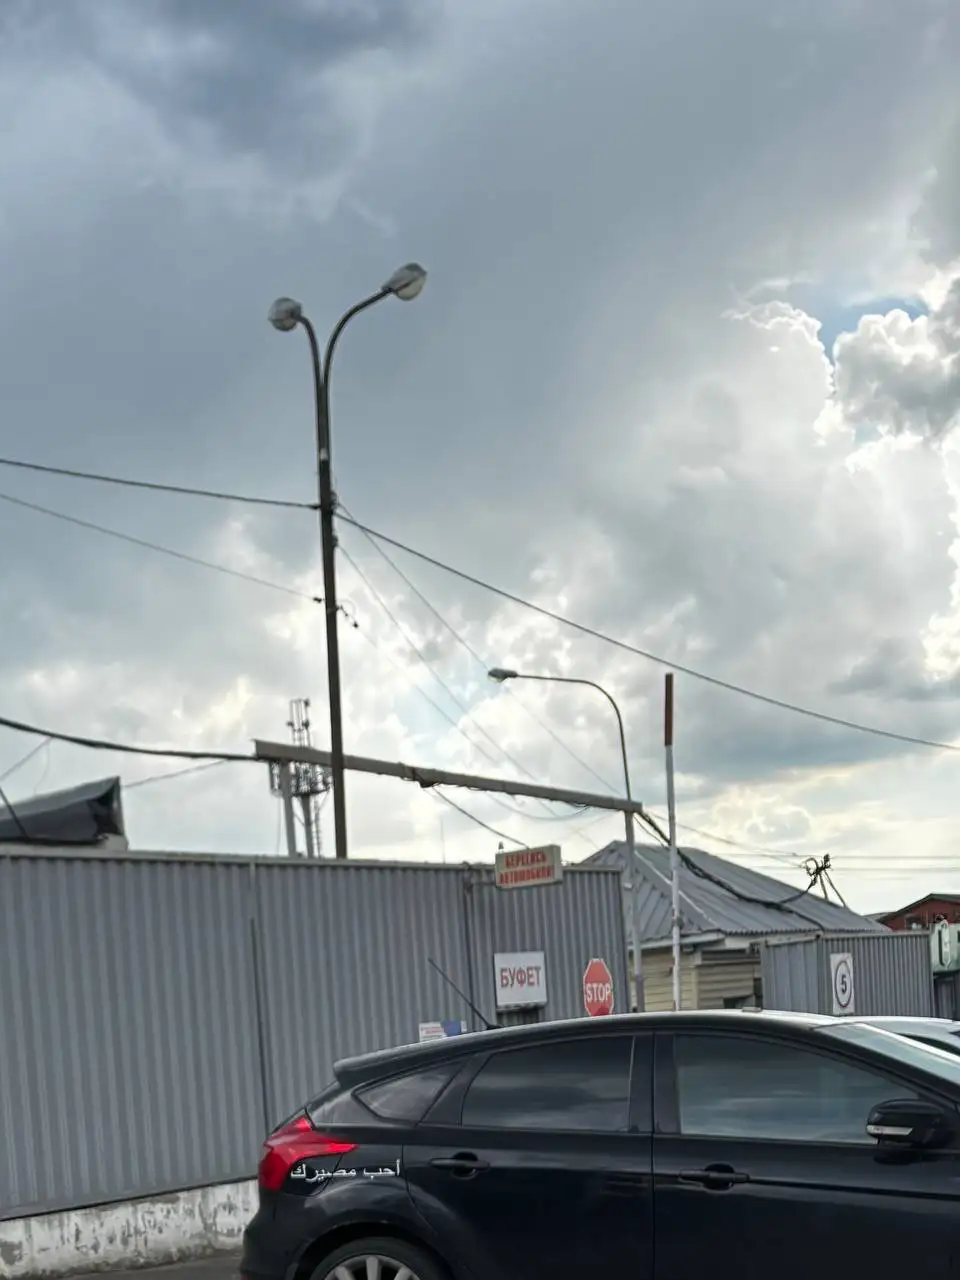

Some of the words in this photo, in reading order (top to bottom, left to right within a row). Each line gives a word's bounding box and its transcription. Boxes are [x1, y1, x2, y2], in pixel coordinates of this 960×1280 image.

[500, 966, 542, 988] БУФЕТ
[840, 974, 848, 994] 5
[586, 982, 611, 1002] STOP
